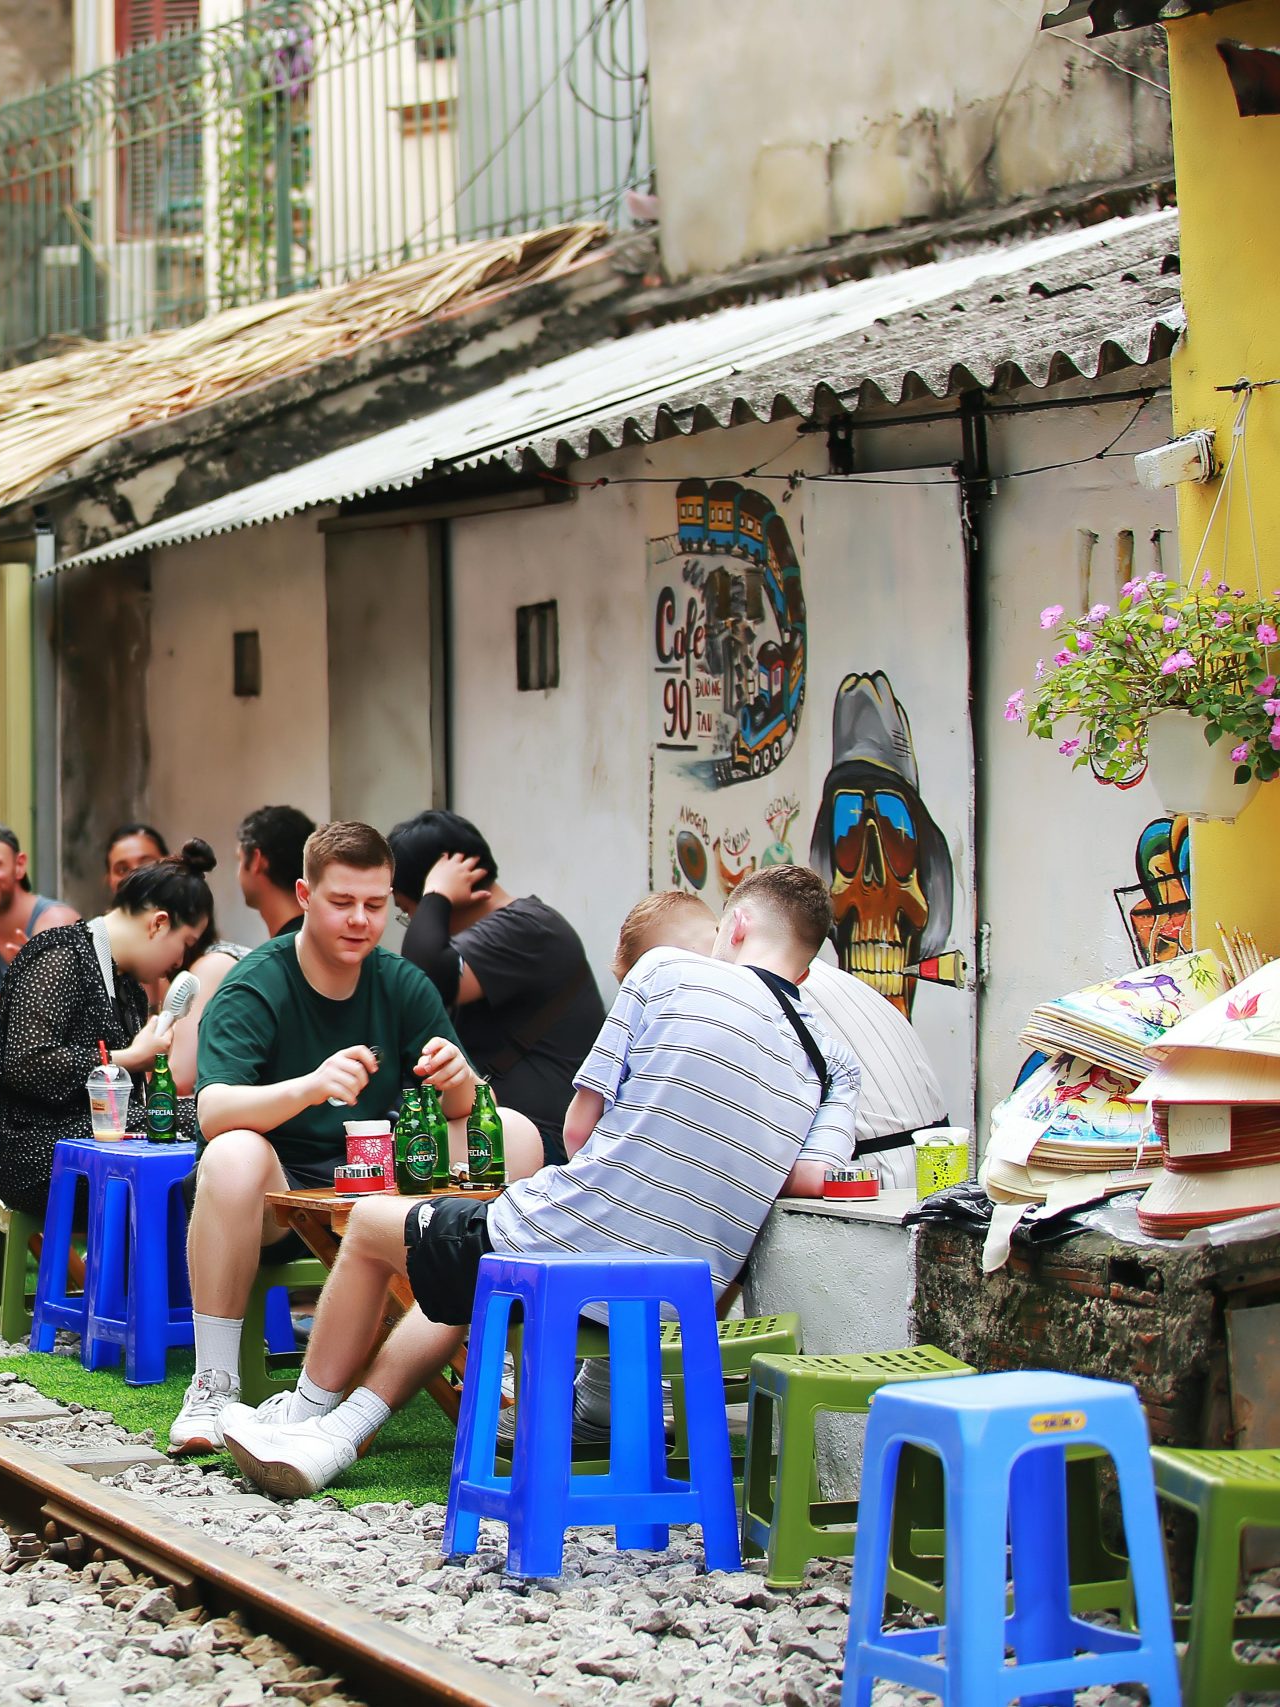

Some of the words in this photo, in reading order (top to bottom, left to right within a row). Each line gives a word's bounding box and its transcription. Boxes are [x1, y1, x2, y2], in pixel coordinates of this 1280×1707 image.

[656, 586, 705, 680] Café
[664, 678, 692, 740] 90
[468, 1149, 491, 1157] ECIAL
